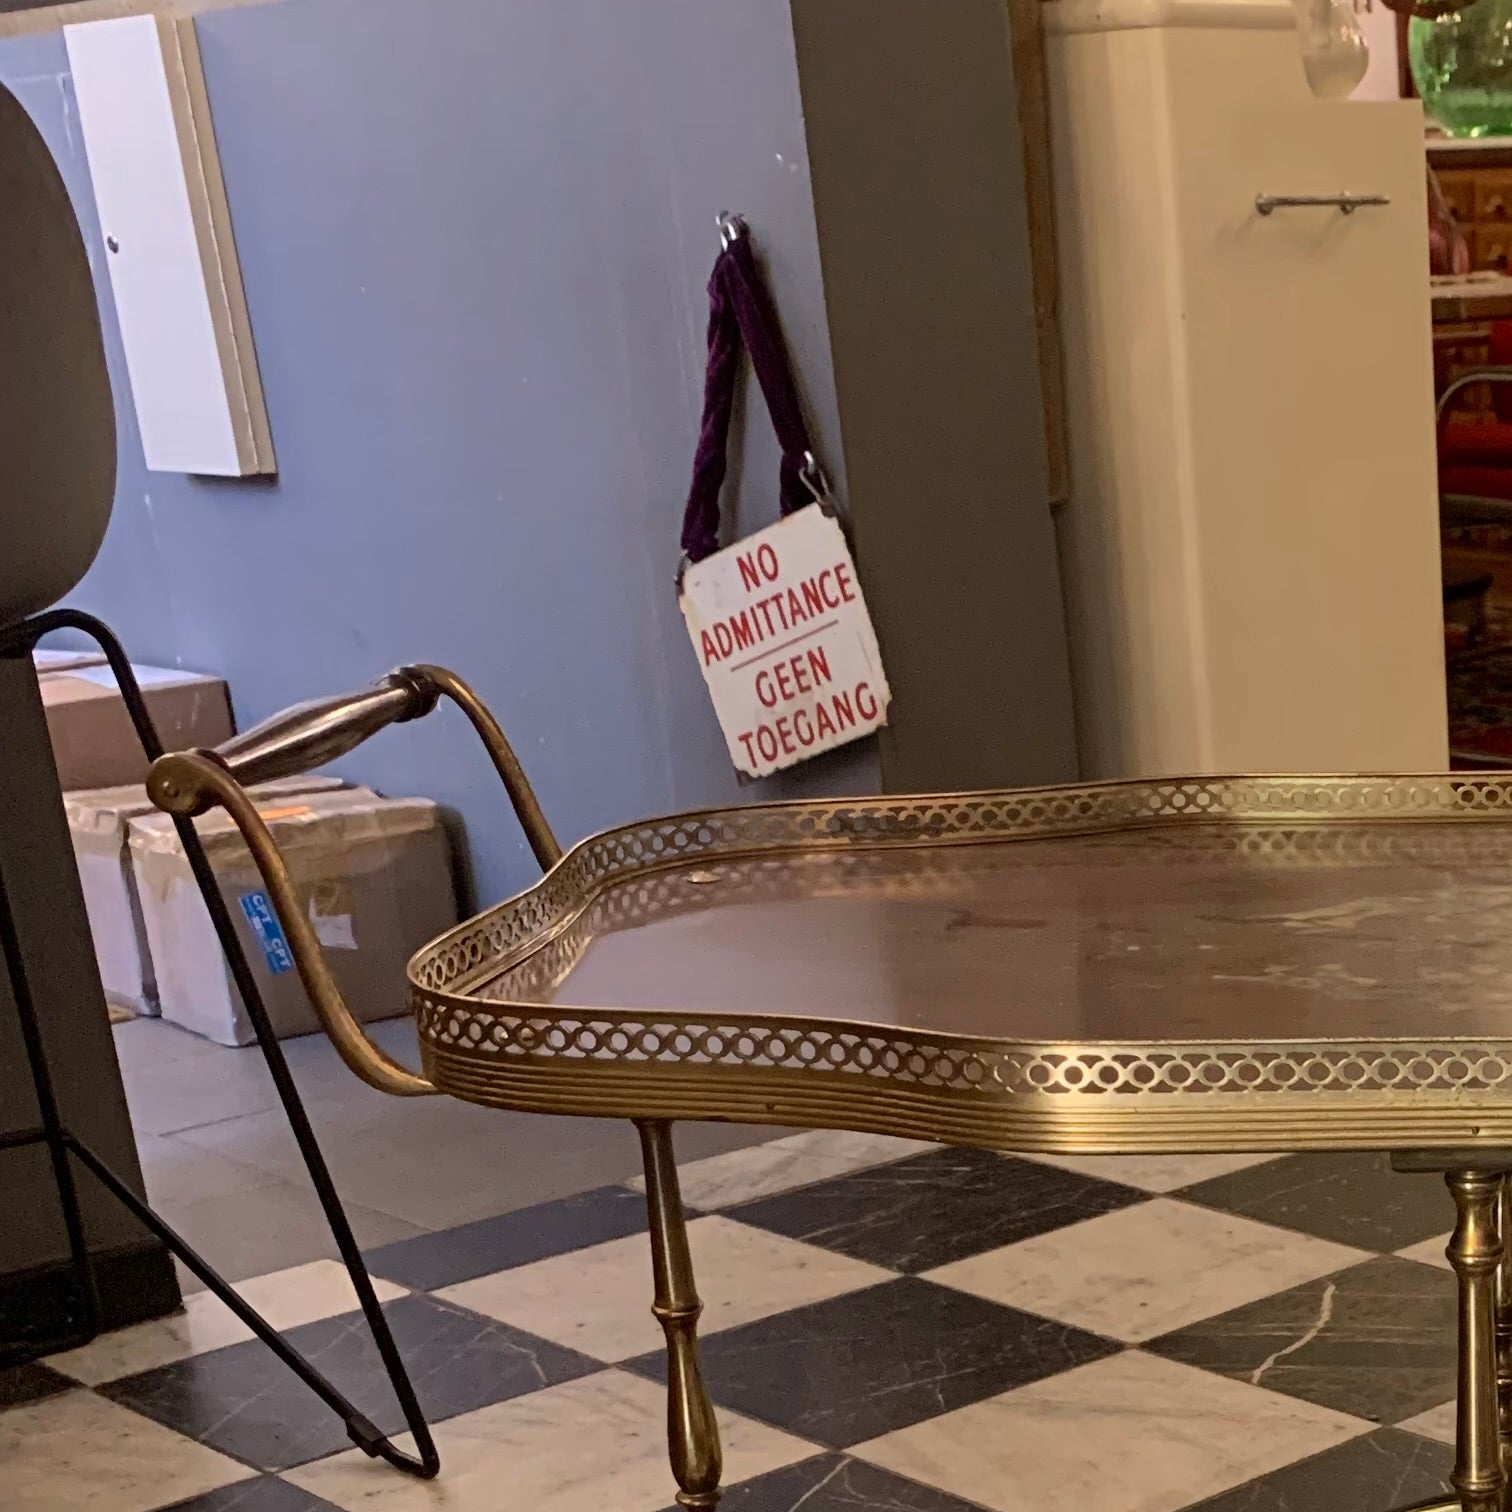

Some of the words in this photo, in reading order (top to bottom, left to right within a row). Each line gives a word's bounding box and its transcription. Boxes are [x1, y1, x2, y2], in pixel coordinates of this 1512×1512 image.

[736, 543, 779, 592] NO
[700, 562, 856, 667] ADMITTANCE
[755, 646, 832, 708] GEEN
[737, 682, 878, 768] TOEGANG
